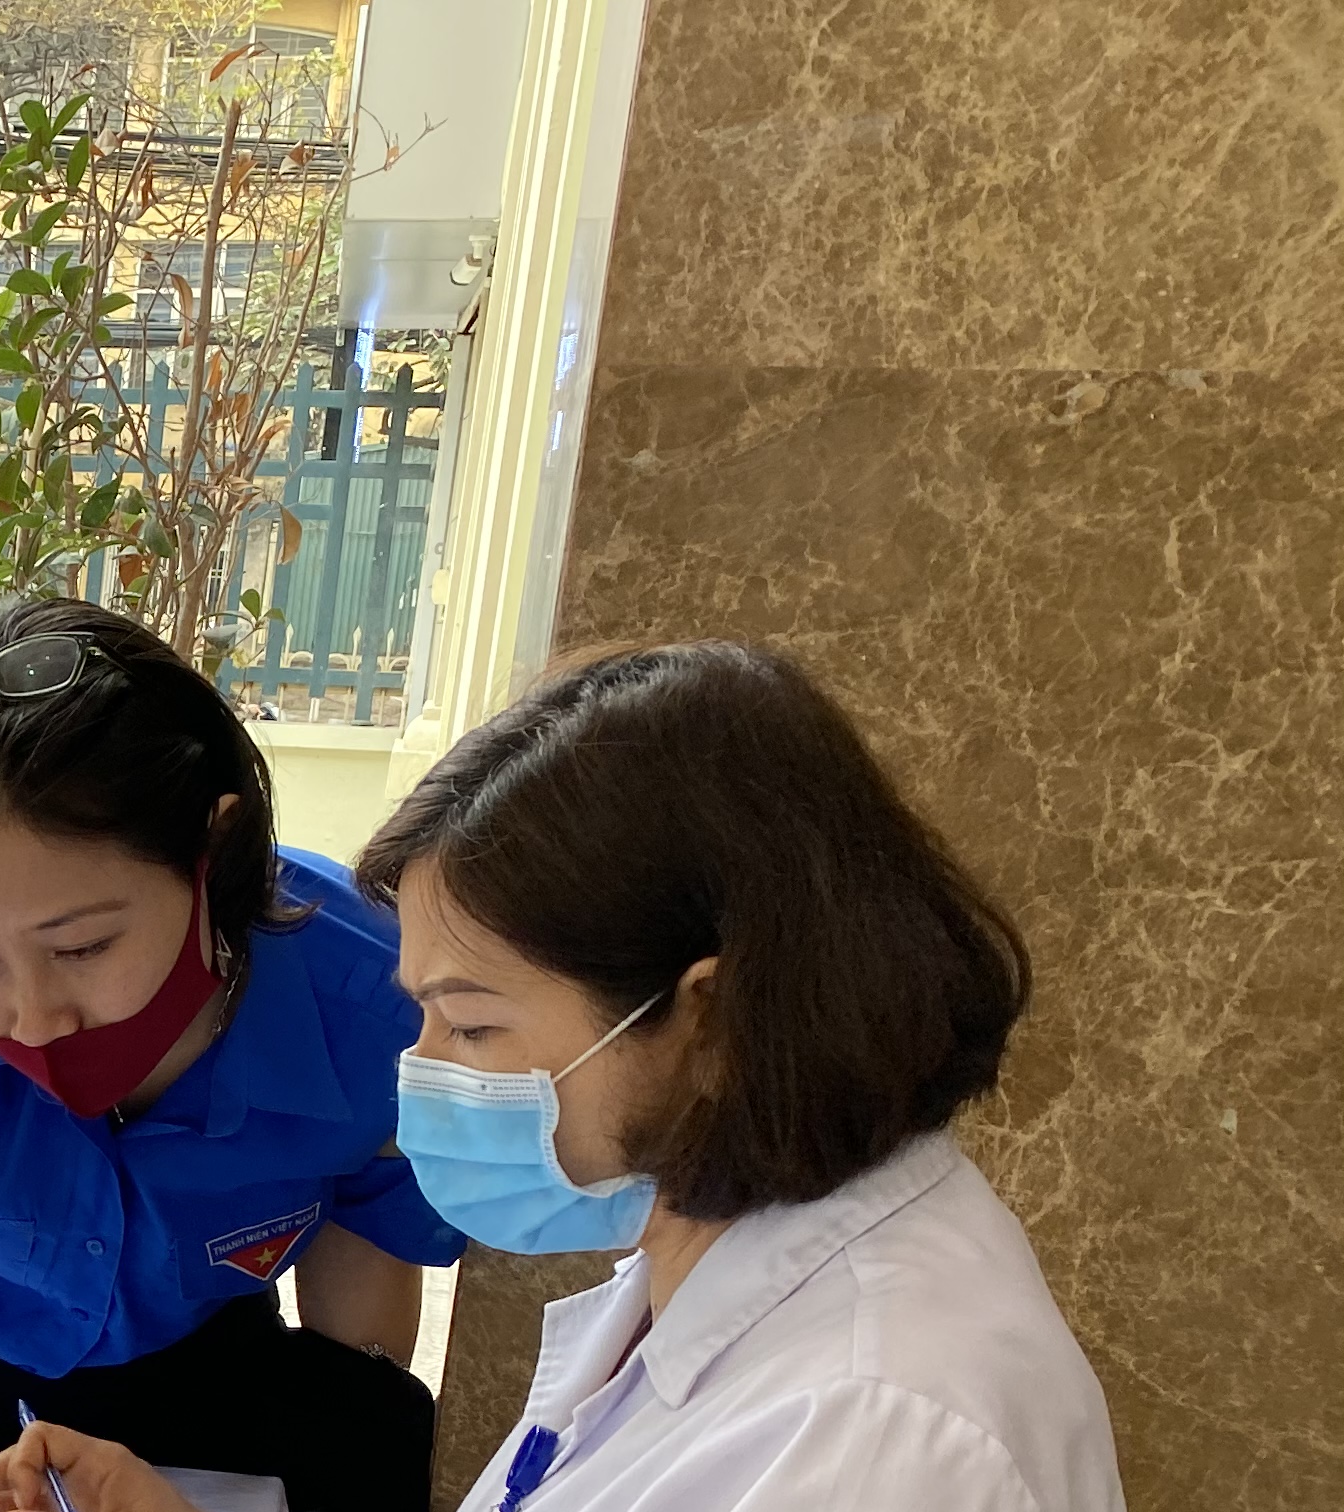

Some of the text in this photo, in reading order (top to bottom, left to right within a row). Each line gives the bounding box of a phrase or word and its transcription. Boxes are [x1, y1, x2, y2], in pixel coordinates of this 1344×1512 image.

[214, 1238, 245, 1256] THANH
[271, 1220, 292, 1235] VIỆT
[294, 1211, 315, 1227] NAM
